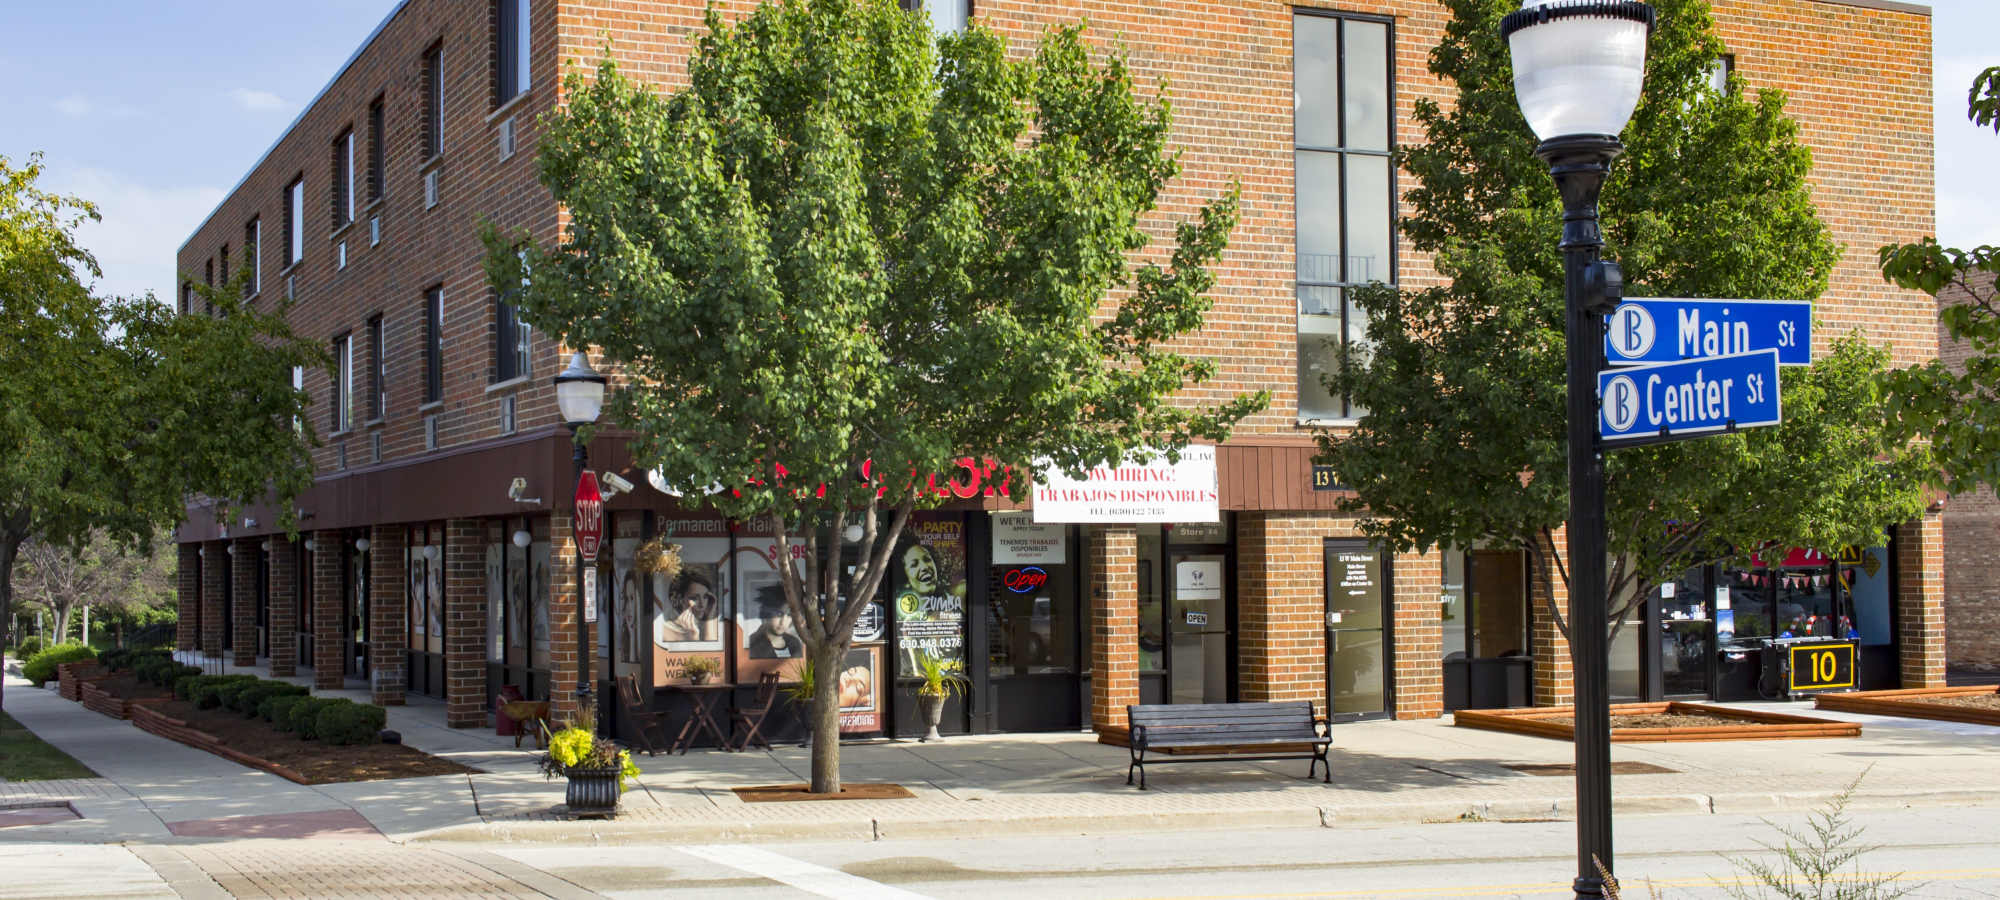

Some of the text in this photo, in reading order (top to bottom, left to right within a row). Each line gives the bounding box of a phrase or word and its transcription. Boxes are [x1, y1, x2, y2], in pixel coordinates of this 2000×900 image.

[1678, 308, 1750, 355] Main
[1777, 320, 1796, 347] St
[1646, 368, 1733, 426] Center
[1746, 373, 1765, 404] St
[1113, 467, 1176, 482] HIRING!
[1315, 471, 1329, 486] 13
[1039, 488, 1217, 503] TRABAJOS DISPONIBLES
[576, 499, 600, 532] STOP
[1000, 517, 1026, 526] WE'RE
[657, 515, 728, 533] Permanent
[923, 521, 963, 533] PARTY
[1180, 527, 1204, 536] Store
[1004, 569, 1048, 590] Open
[920, 595, 963, 612] ZUMBA
[1188, 614, 1207, 623] OPEN
[1810, 651, 1838, 682] 10
